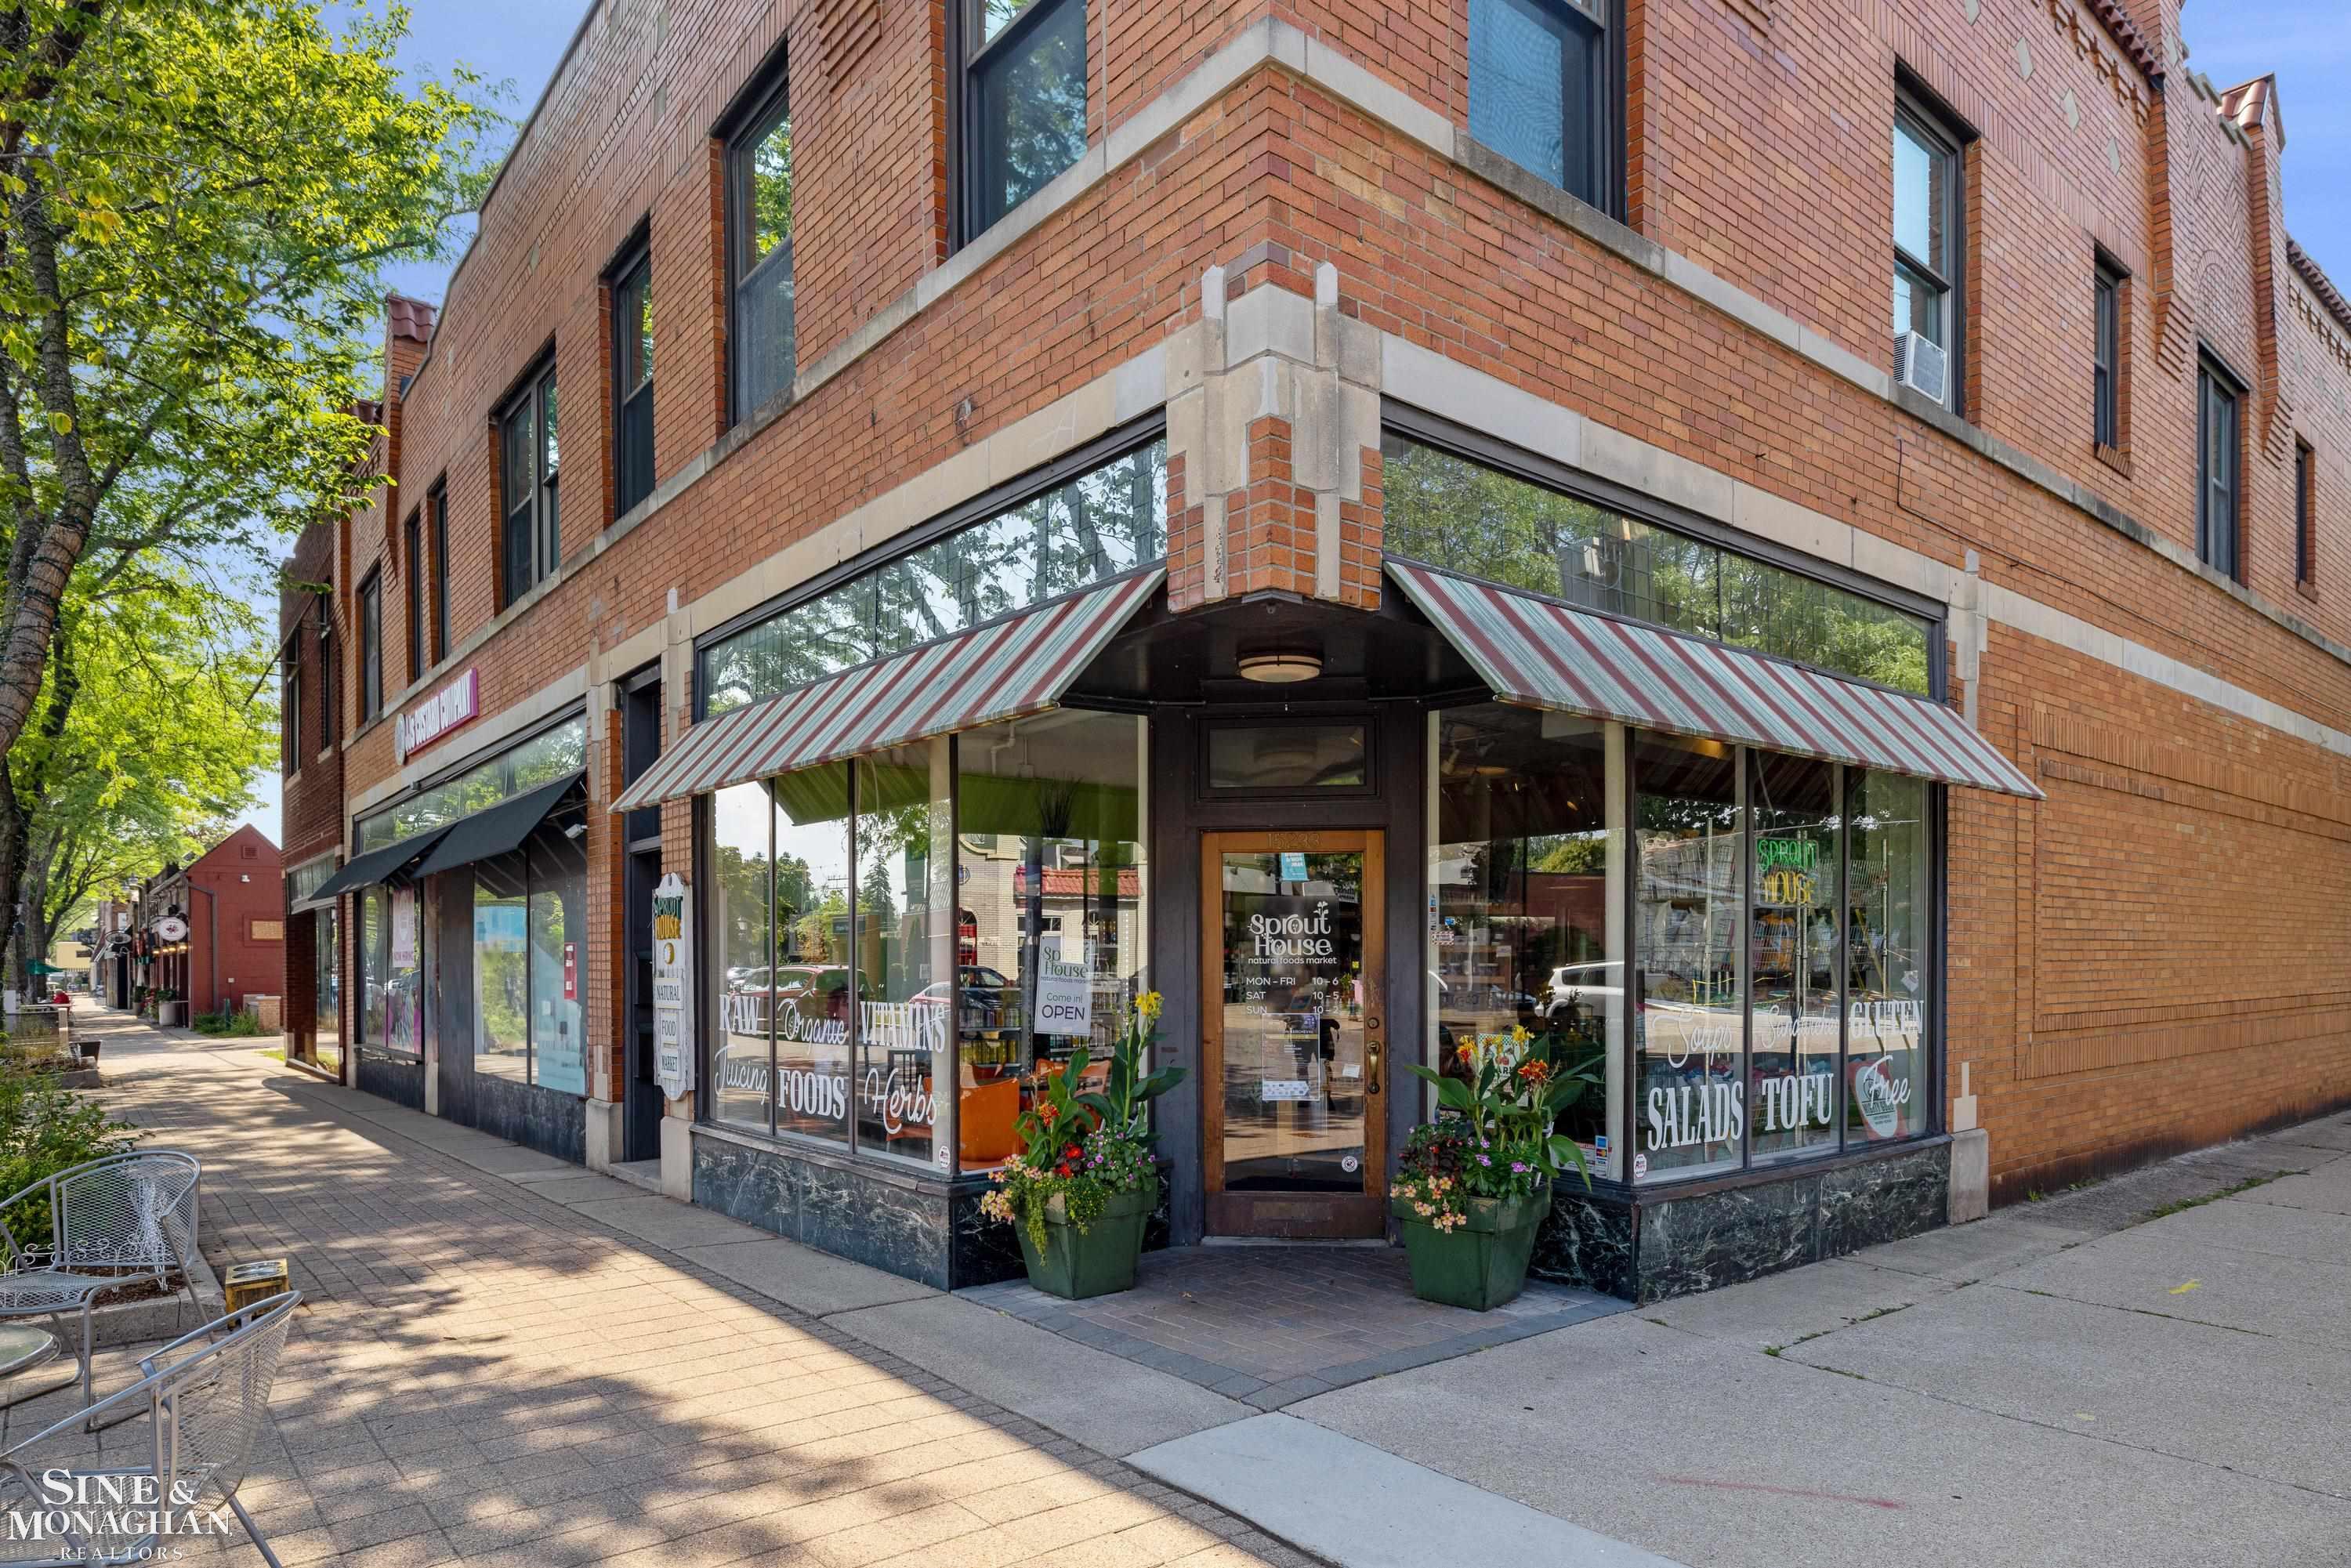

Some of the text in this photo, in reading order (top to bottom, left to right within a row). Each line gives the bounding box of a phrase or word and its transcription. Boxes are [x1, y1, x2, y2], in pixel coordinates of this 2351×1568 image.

[415, 695, 440, 746] CUSTARD
[440, 668, 472, 730] COMPANY
[1267, 833, 1323, 848] 15233
[1758, 839, 1817, 872] SPROUT
[1763, 871, 1814, 904] HOUSE
[653, 896, 683, 918] SPROUT
[655, 914, 681, 940] HOUSE
[1248, 913, 1331, 935] Sprout
[1044, 947, 1090, 964] Spt
[1255, 935, 1333, 956] House
[1045, 961, 1089, 978] House
[1246, 977, 1271, 986] MON
[1280, 977, 1296, 986] FRI
[1312, 977, 1324, 986] 10
[1332, 977, 1339, 986] 6
[657, 984, 680, 1001] NATURAL
[1046, 992, 1083, 1003] Come in!
[1246, 991, 1266, 1000] SAT
[719, 994, 760, 1036] RAW
[1041, 1005, 1085, 1020] OPEN
[1246, 1005, 1267, 1014] SUN
[1313, 1005, 1324, 1014] 10
[1850, 1001, 1925, 1039] GLUTEN
[661, 1019, 676, 1037] FOOD
[777, 998, 848, 1056] Organic
[860, 1001, 946, 1053] VITAMINS
[1652, 1007, 1732, 1069] Soups
[1753, 1004, 1840, 1048] Sandwiches
[661, 1053, 678, 1072] MARKET
[715, 1044, 769, 1106] Juicing
[778, 1069, 846, 1121] FOODS
[1863, 1054, 1911, 1109] Free
[864, 1066, 938, 1135] Herbs
[1762, 1073, 1835, 1132] TOFU
[1647, 1081, 1744, 1151] SALADS
